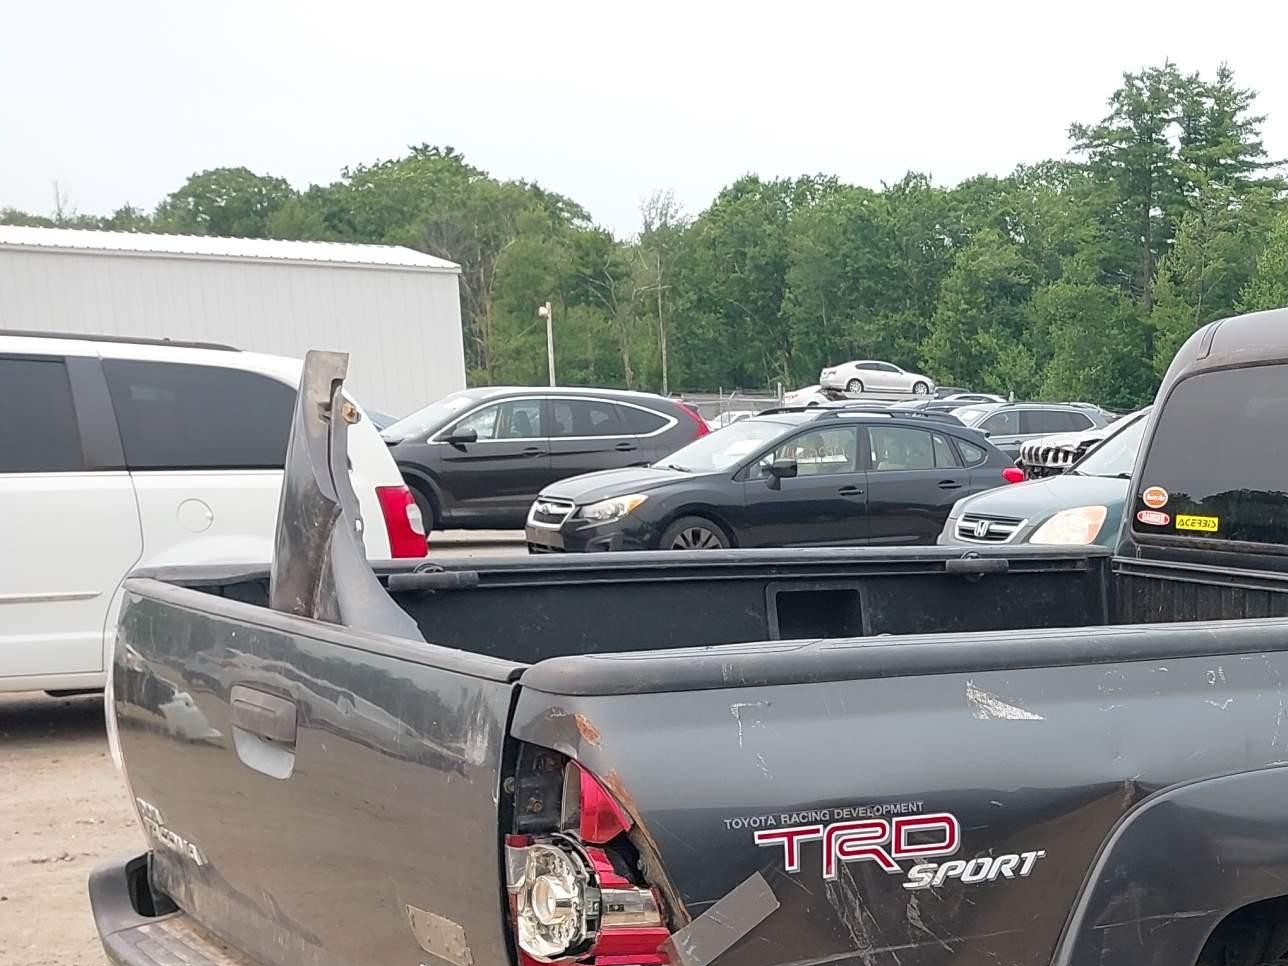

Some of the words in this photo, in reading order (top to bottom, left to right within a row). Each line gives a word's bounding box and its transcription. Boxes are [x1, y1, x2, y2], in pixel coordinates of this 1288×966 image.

[724, 815, 776, 830] TOYOTA
[781, 810, 830, 825] RACING
[834, 801, 924, 820] DEVELOPMENT
[754, 812, 961, 881] TRD
[903, 850, 1048, 891] SPORT
